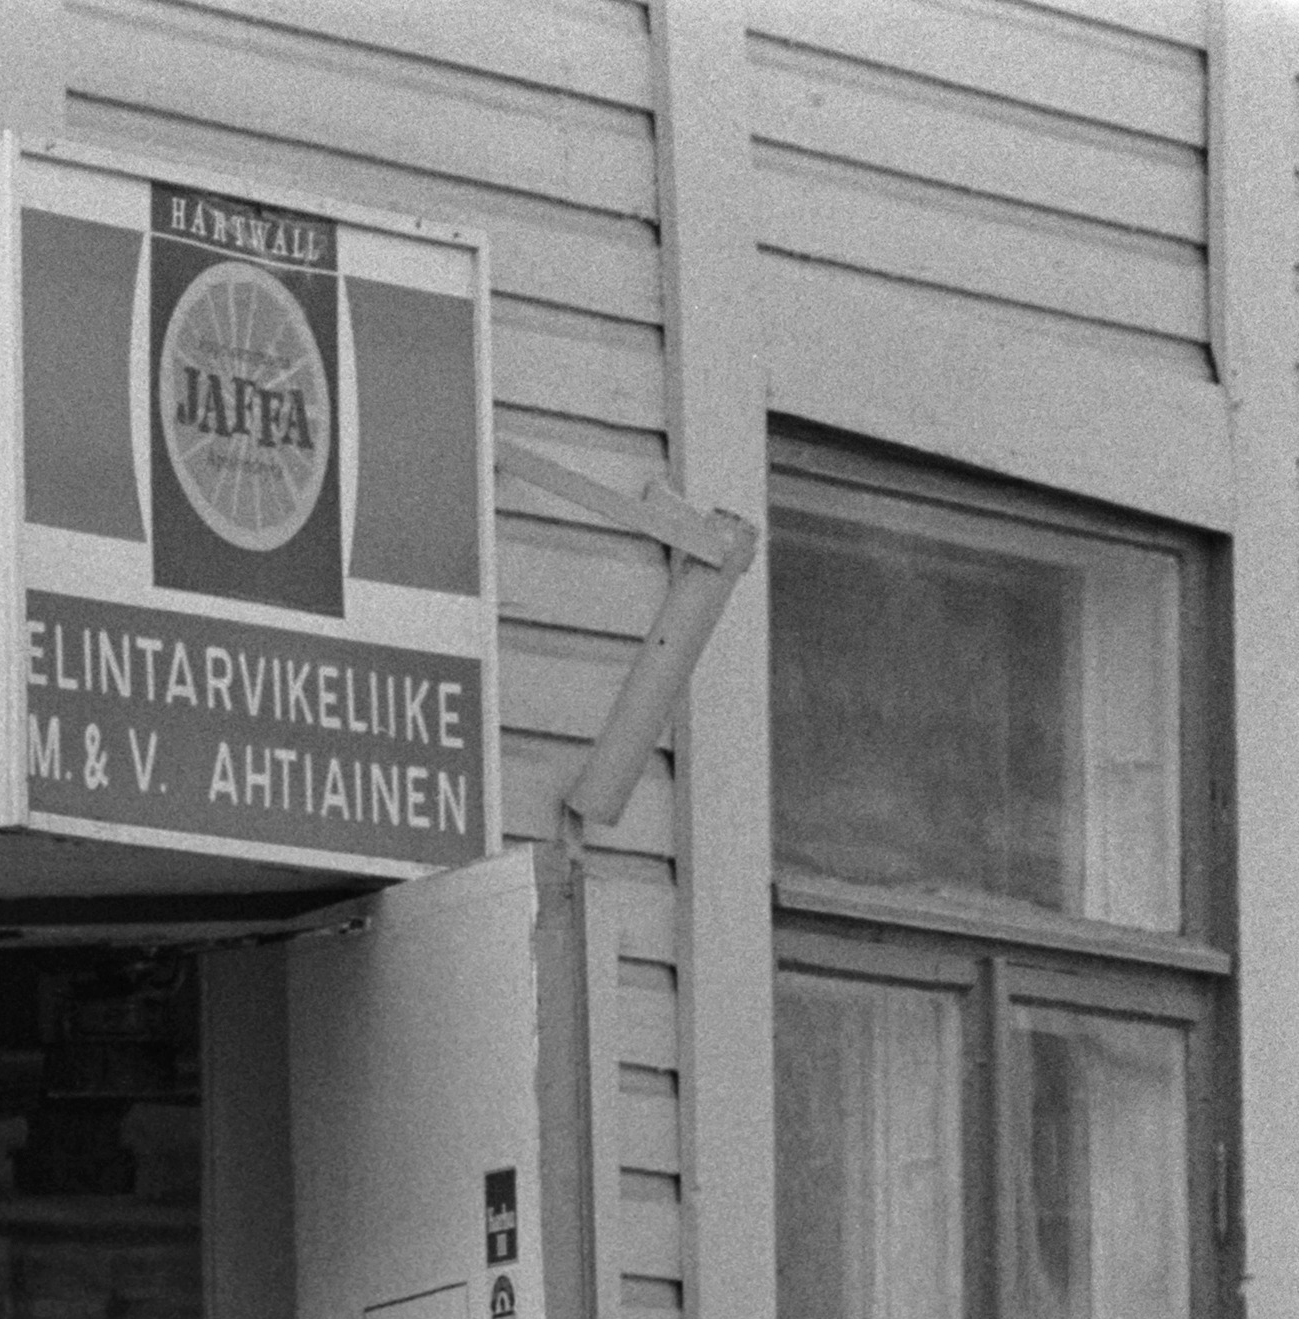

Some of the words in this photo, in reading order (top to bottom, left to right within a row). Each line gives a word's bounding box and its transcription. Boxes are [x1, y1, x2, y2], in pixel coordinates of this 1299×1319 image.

[170, 198, 320, 260] HARTWALL
[177, 367, 315, 450] JAFFA
[26, 621, 464, 749] ELINTARVIKELIIKE
[27, 715, 72, 781] M.
[84, 724, 108, 790] &
[129, 728, 167, 794] V.
[210, 741, 467, 835] AHTIAINEN
